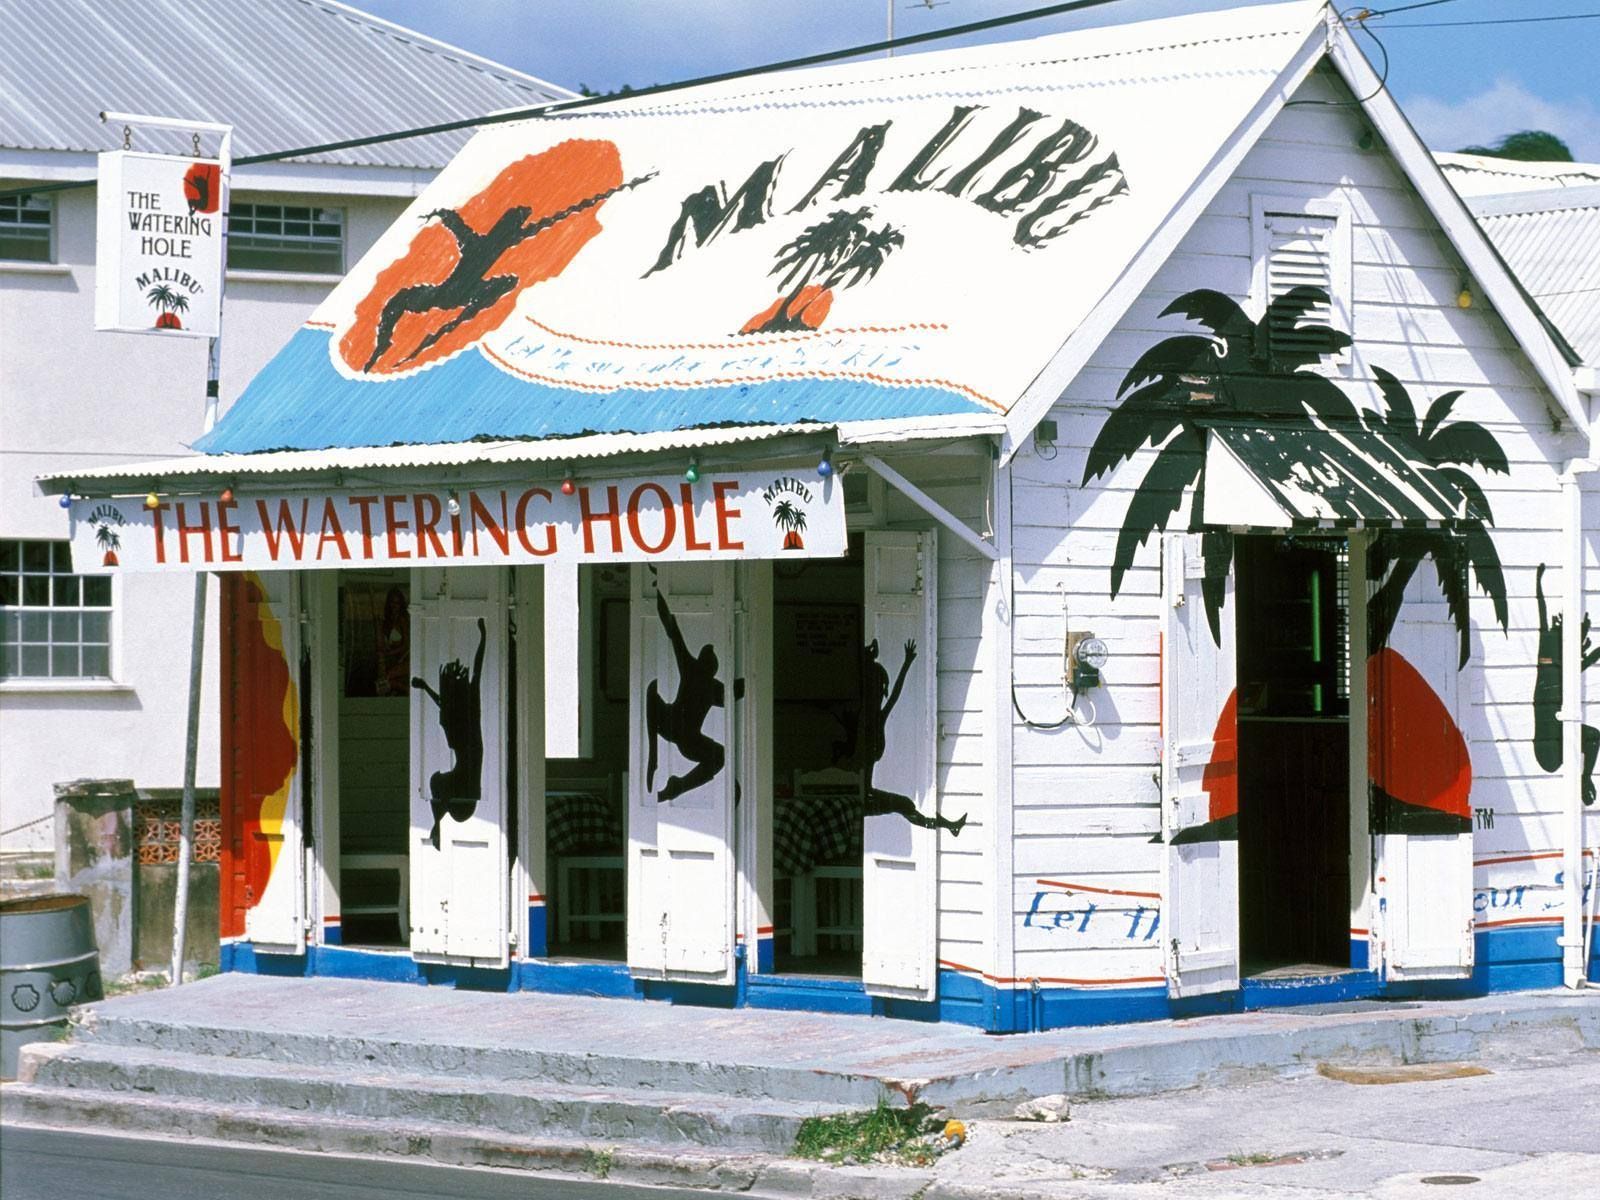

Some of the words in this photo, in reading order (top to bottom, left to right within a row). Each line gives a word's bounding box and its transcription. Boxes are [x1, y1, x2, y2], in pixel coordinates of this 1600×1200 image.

[127, 190, 161, 210] THE
[640, 104, 1131, 279] MALIBU
[128, 211, 212, 237] WATERING
[141, 236, 192, 258] HOLE
[135, 266, 202, 295] MALIBU
[763, 476, 813, 506] MALIBU
[87, 503, 127, 529] MALIBU
[142, 499, 243, 564] THE
[255, 487, 558, 562] WATERING
[578, 480, 745, 554] HOLE
[1475, 808, 1495, 830] TM
